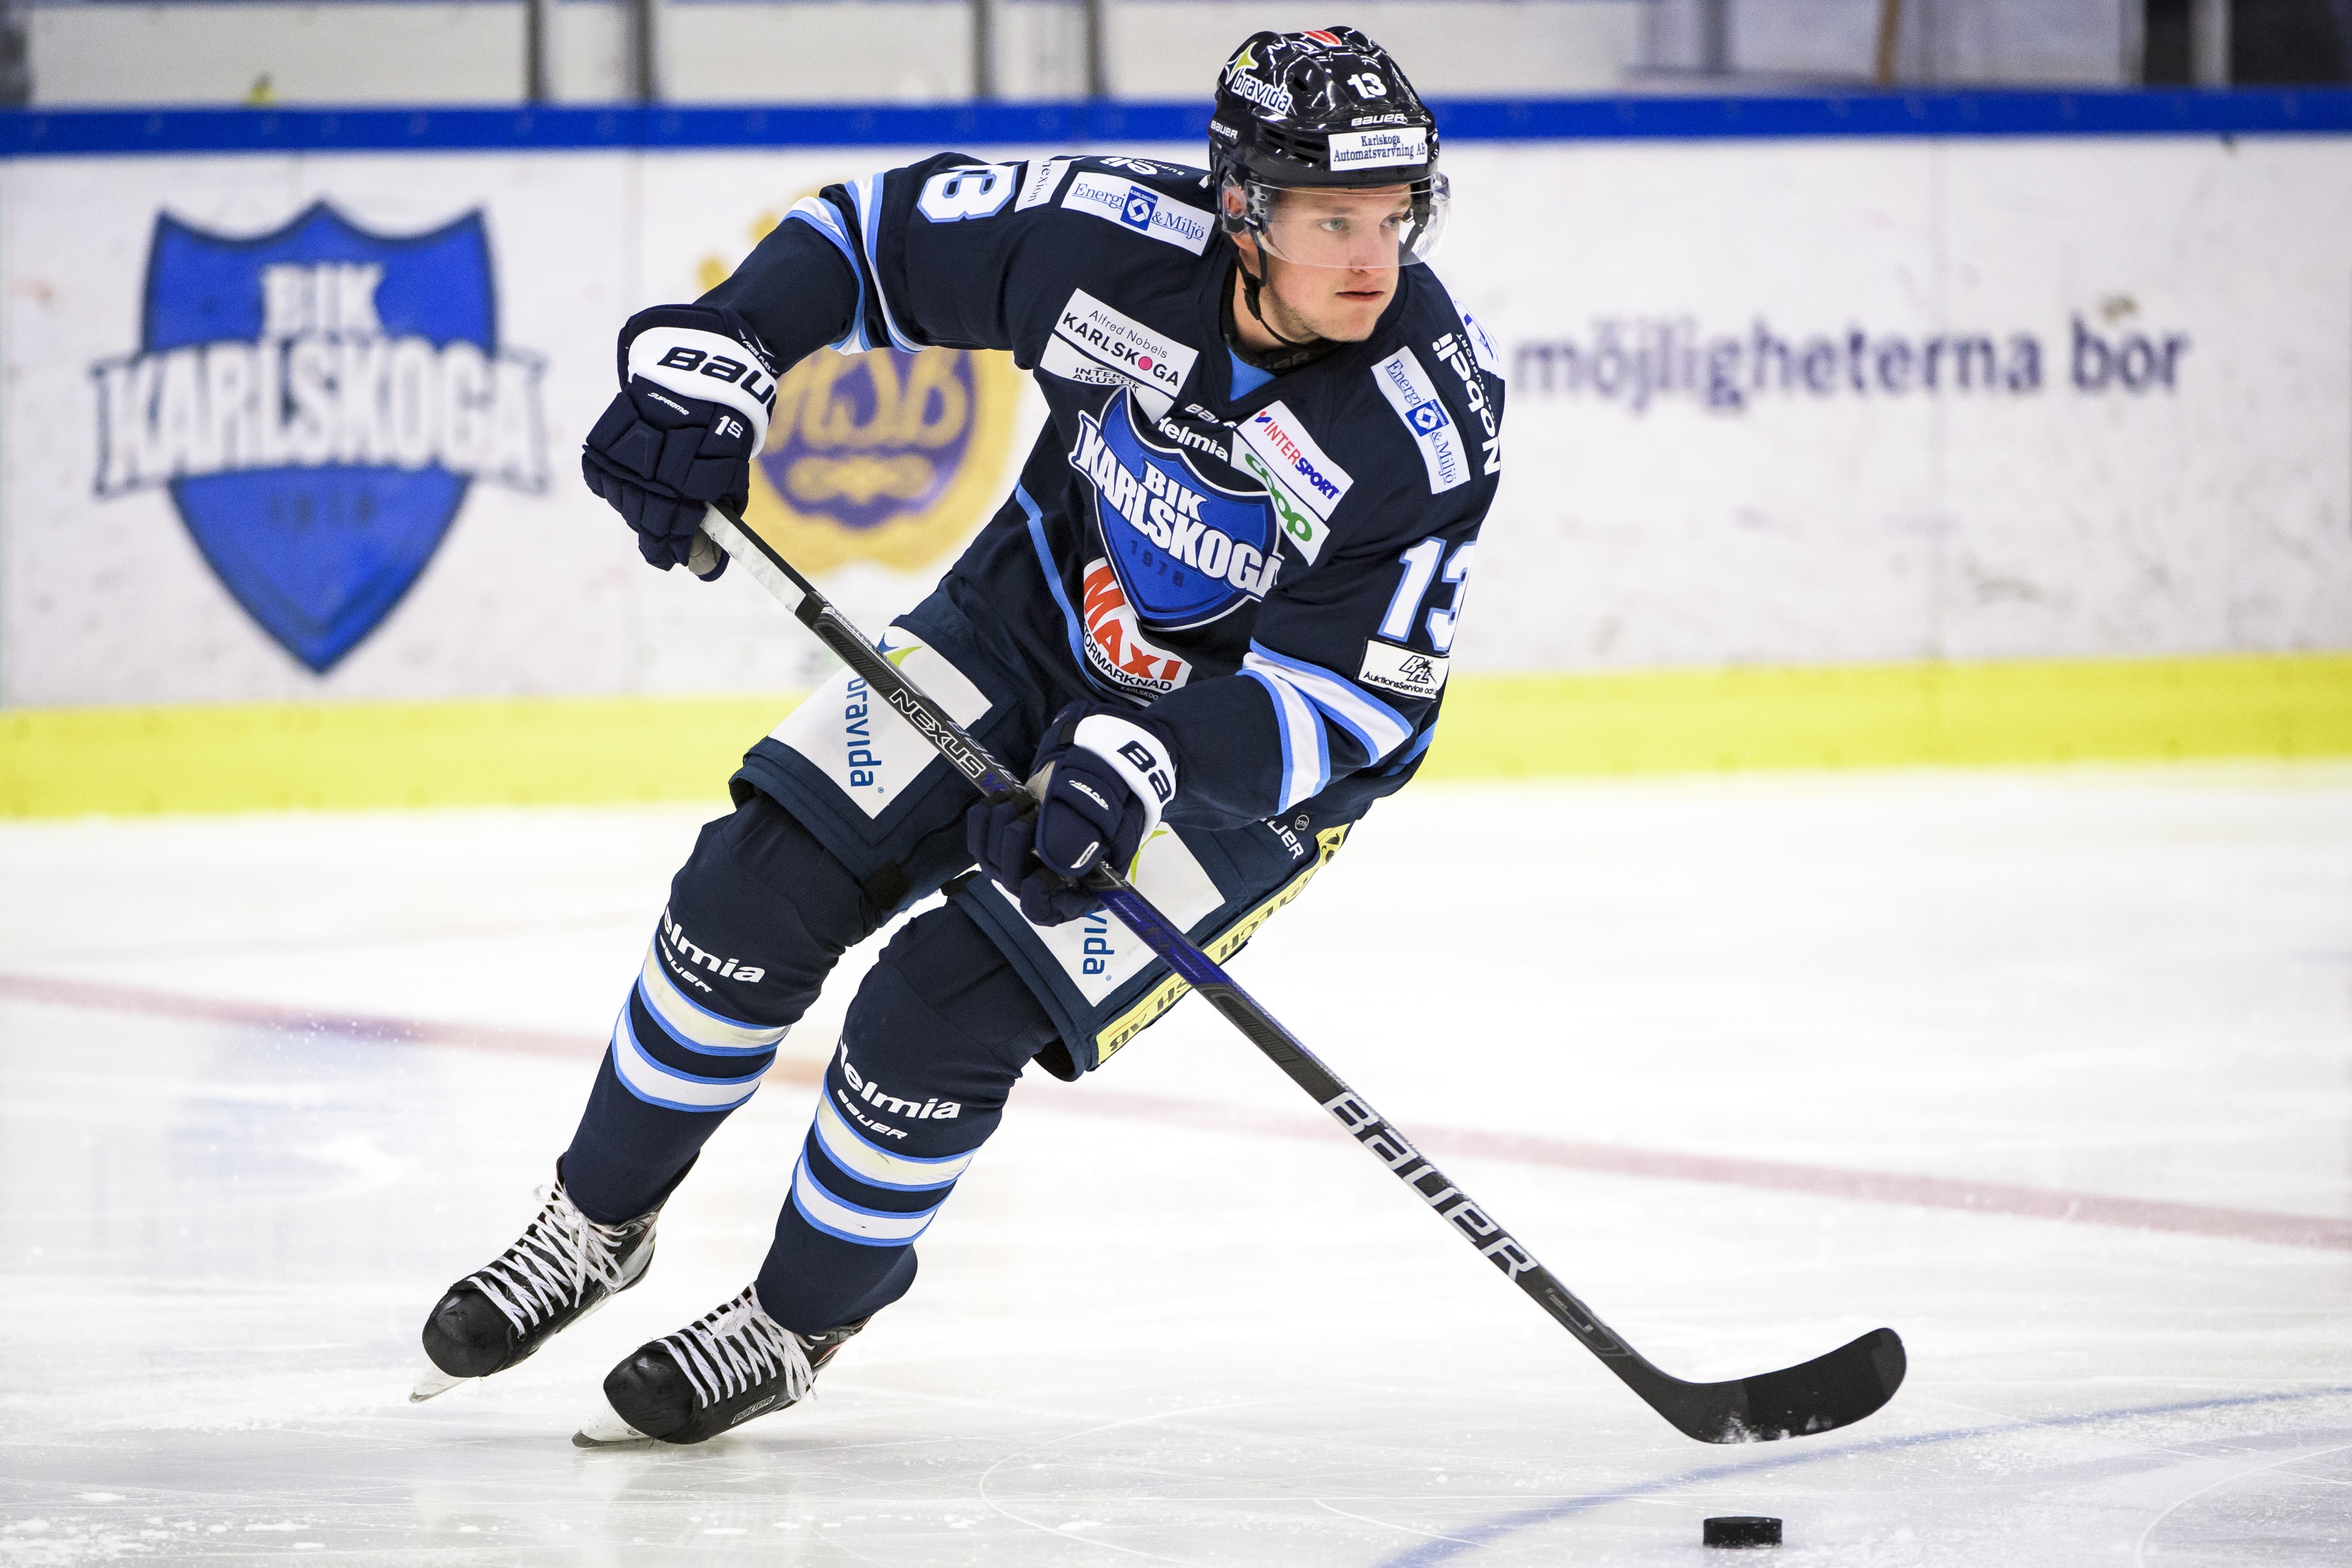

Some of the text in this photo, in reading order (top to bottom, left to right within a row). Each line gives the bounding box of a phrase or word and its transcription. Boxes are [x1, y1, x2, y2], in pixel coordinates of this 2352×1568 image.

[1232, 68, 1292, 115] bravida
[1347, 73, 1387, 99] 13
[1210, 120, 1238, 140] BAUER
[1351, 113, 1407, 126] BAUER
[1361, 134, 1401, 147] Karlskoga
[1334, 142, 1415, 162] Automatsvarvning
[1073, 182, 1126, 209] Energi
[1129, 189, 1157, 204] KARLSKOGA
[264, 263, 383, 335] BIK
[742, 341, 760, 357] FREE
[1062, 311, 1179, 387] KARLSKOGA
[1088, 310, 1168, 359] Alfred Nobels
[657, 346, 777, 422] BAU
[758, 356, 771, 372] FLEX
[1386, 358, 1426, 408] Energi
[1512, 307, 2045, 418] möjligheterna
[2069, 305, 2187, 394] bor
[100, 338, 542, 487] KARLSKOGA
[648, 392, 690, 416] SUPREME
[1263, 421, 1340, 500] INTERSPORT
[1143, 460, 1208, 521] BIK
[1245, 453, 1313, 542] coop
[1377, 536, 1477, 652] 13
[1083, 564, 1183, 681] MAXI
[1084, 624, 1172, 692] TORMARKNAD
[1120, 686, 1159, 701] KARLSKOG
[844, 677, 882, 787] bravida
[889, 688, 987, 779] NEXUS
[1259, 817, 1304, 860] UER
[1109, 1013, 1147, 1052] AB
[1322, 1091, 1539, 1282] BAUER
